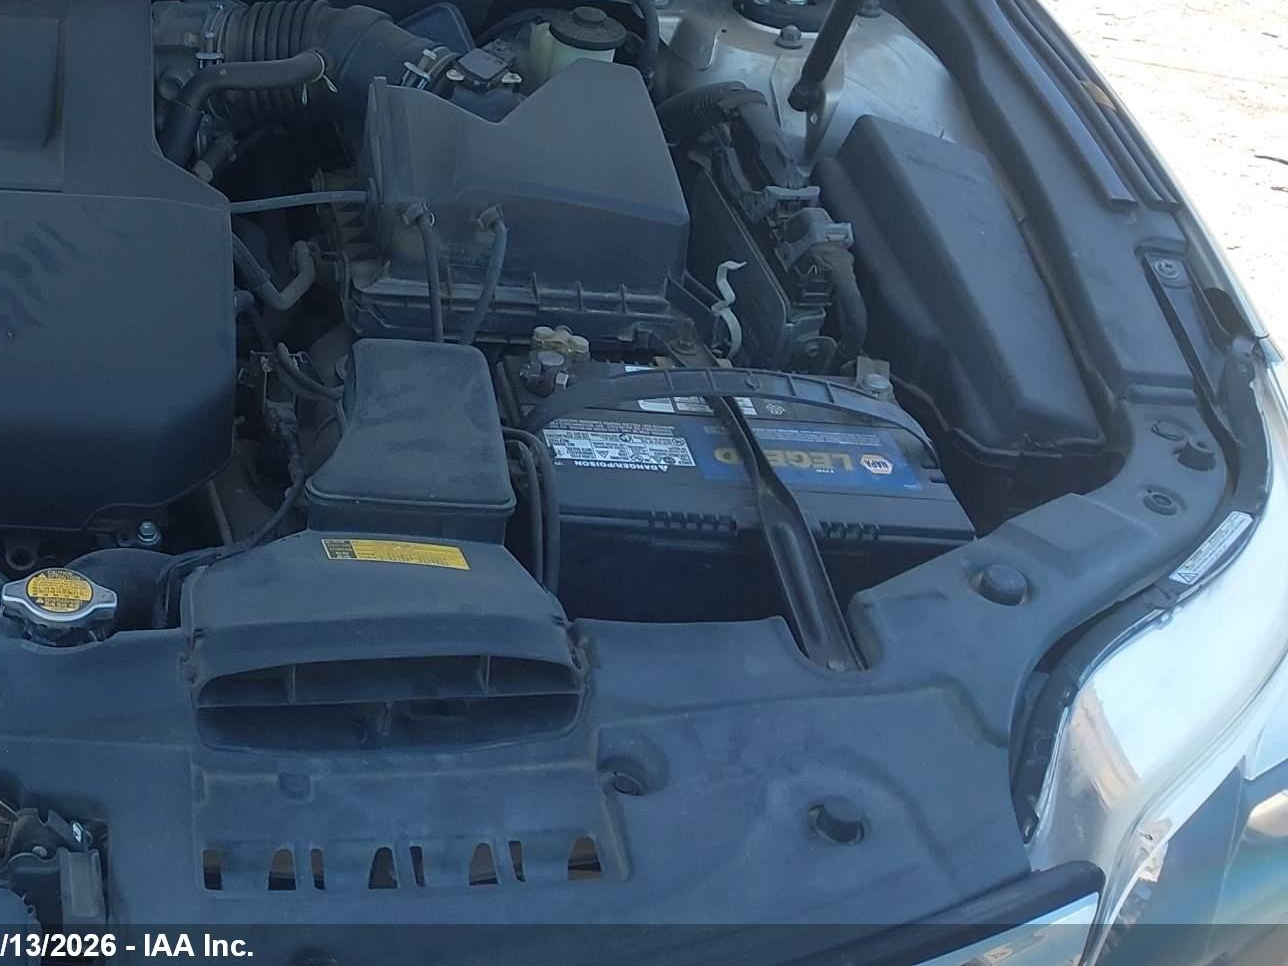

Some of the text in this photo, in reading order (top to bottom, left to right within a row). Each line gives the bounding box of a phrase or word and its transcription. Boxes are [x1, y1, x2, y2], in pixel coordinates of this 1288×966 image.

[574, 459, 659, 472] DANGER/POISON
[715, 447, 854, 471] LEGED
[863, 458, 889, 470] NAPA
